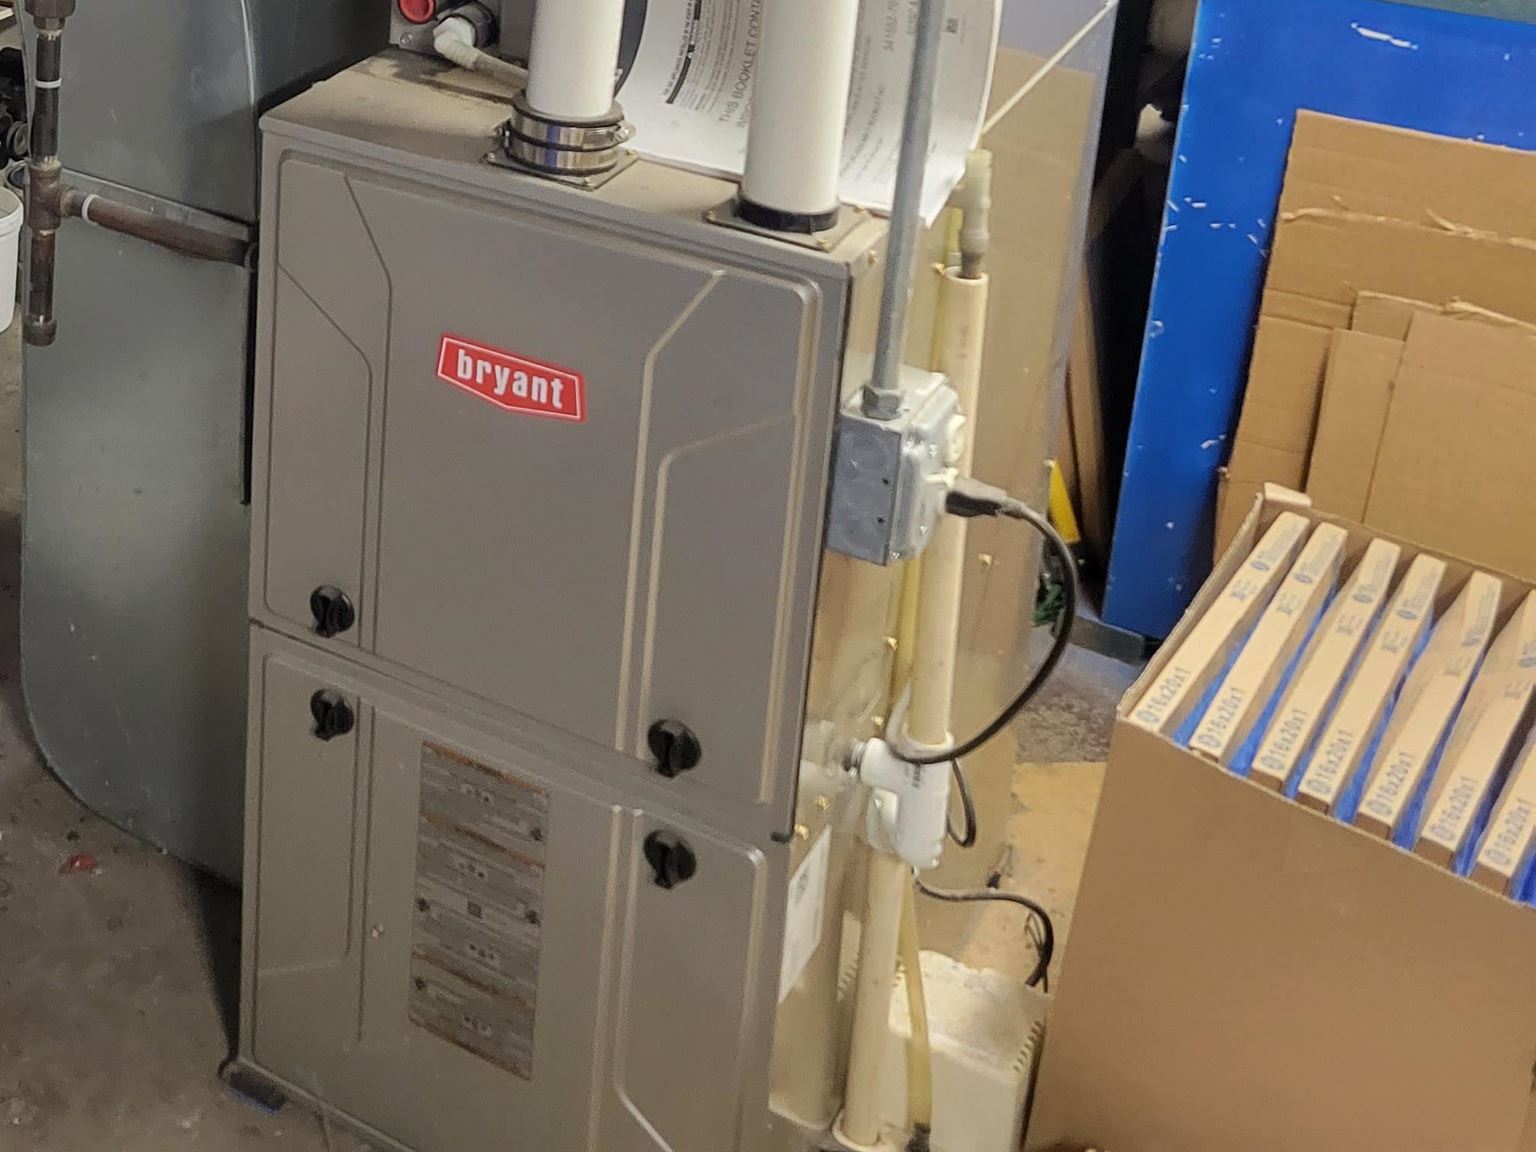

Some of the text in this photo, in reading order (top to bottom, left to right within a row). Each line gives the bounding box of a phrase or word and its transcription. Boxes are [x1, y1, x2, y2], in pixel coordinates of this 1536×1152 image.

[718, 97, 738, 123] THIS
[733, 40, 757, 99] BOOKLET
[457, 348, 564, 409] bryant
